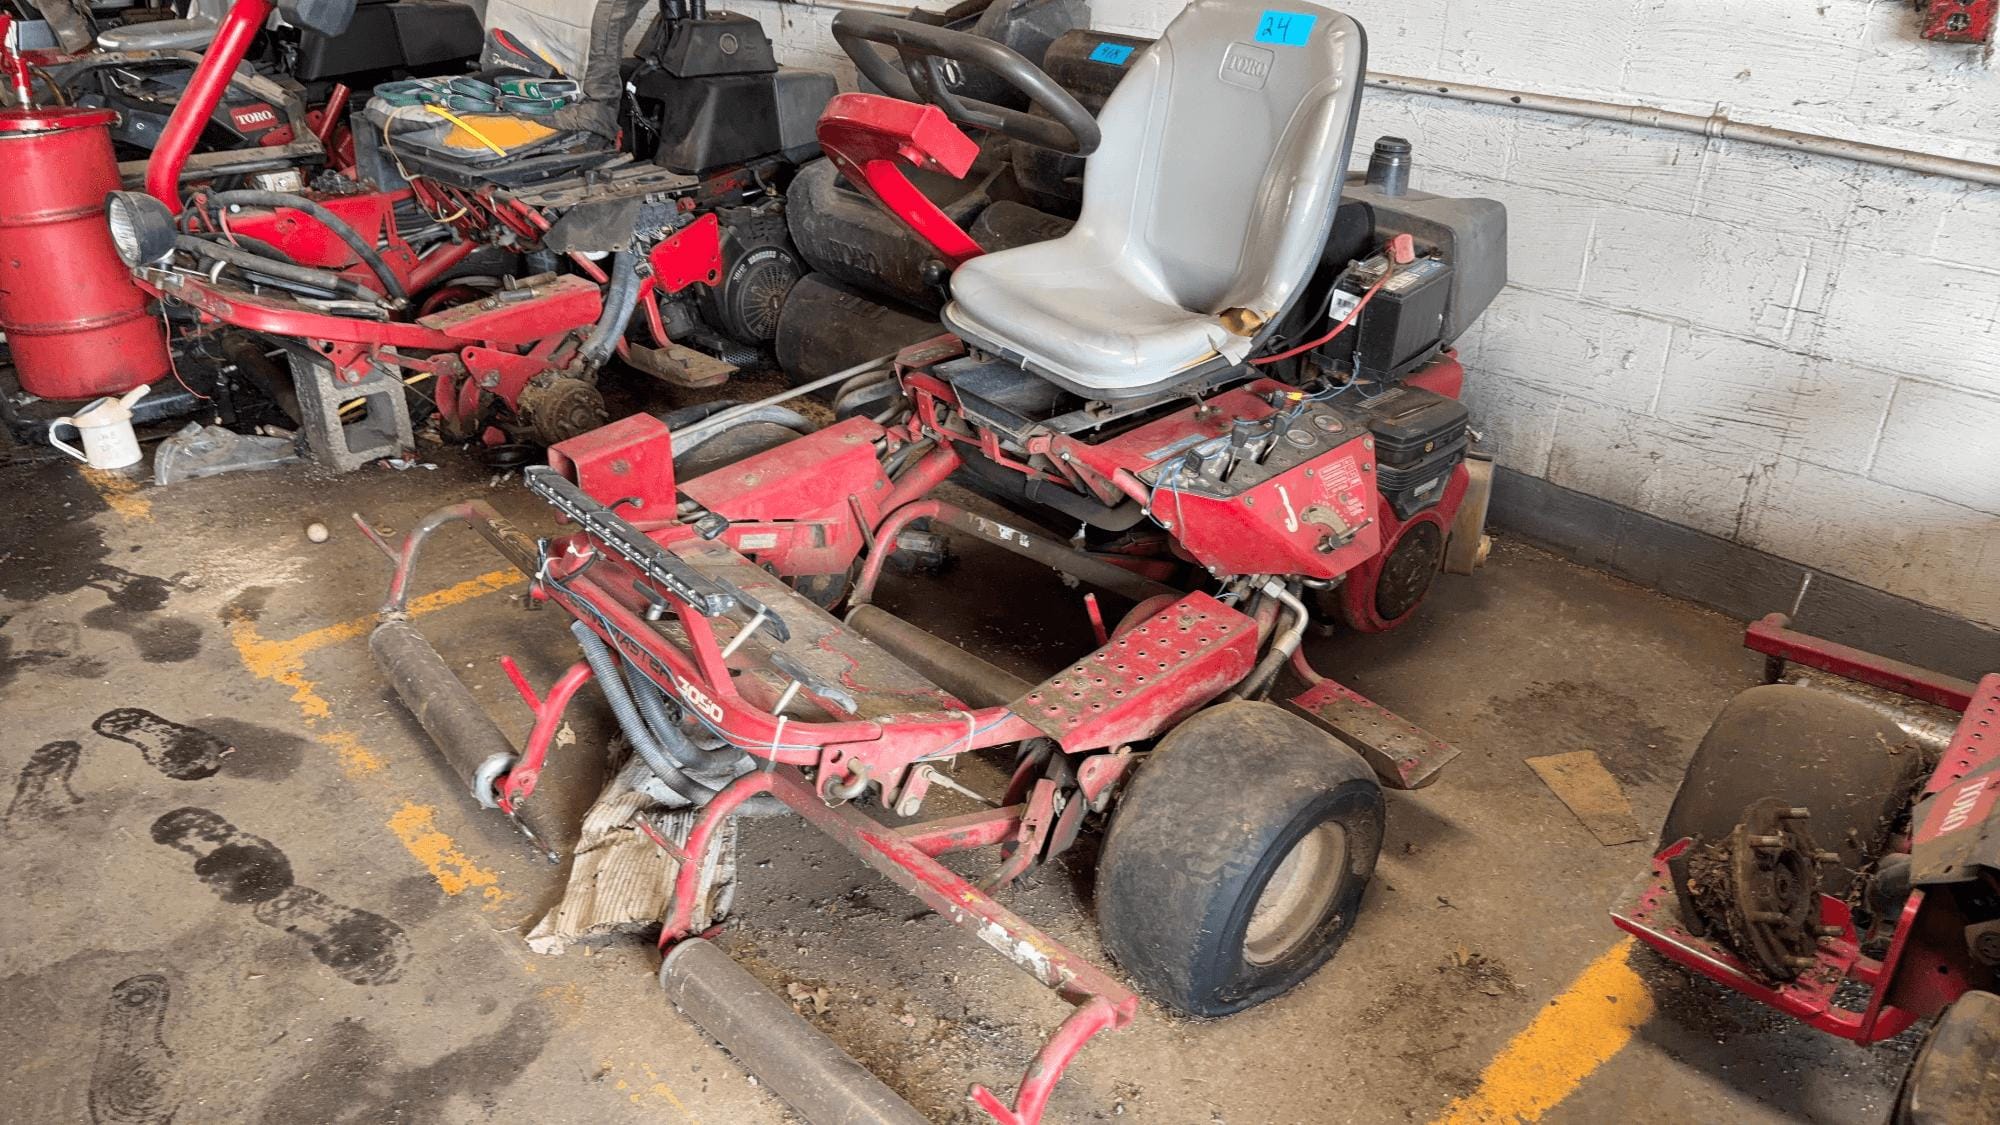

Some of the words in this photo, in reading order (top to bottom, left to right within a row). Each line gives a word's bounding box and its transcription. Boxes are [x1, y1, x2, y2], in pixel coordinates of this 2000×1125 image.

[1261, 16, 1293, 43] 24
[1226, 54, 1268, 79] TORO
[235, 110, 274, 125] TORO
[677, 675, 724, 724] 3050
[1938, 777, 1990, 833] TORO
